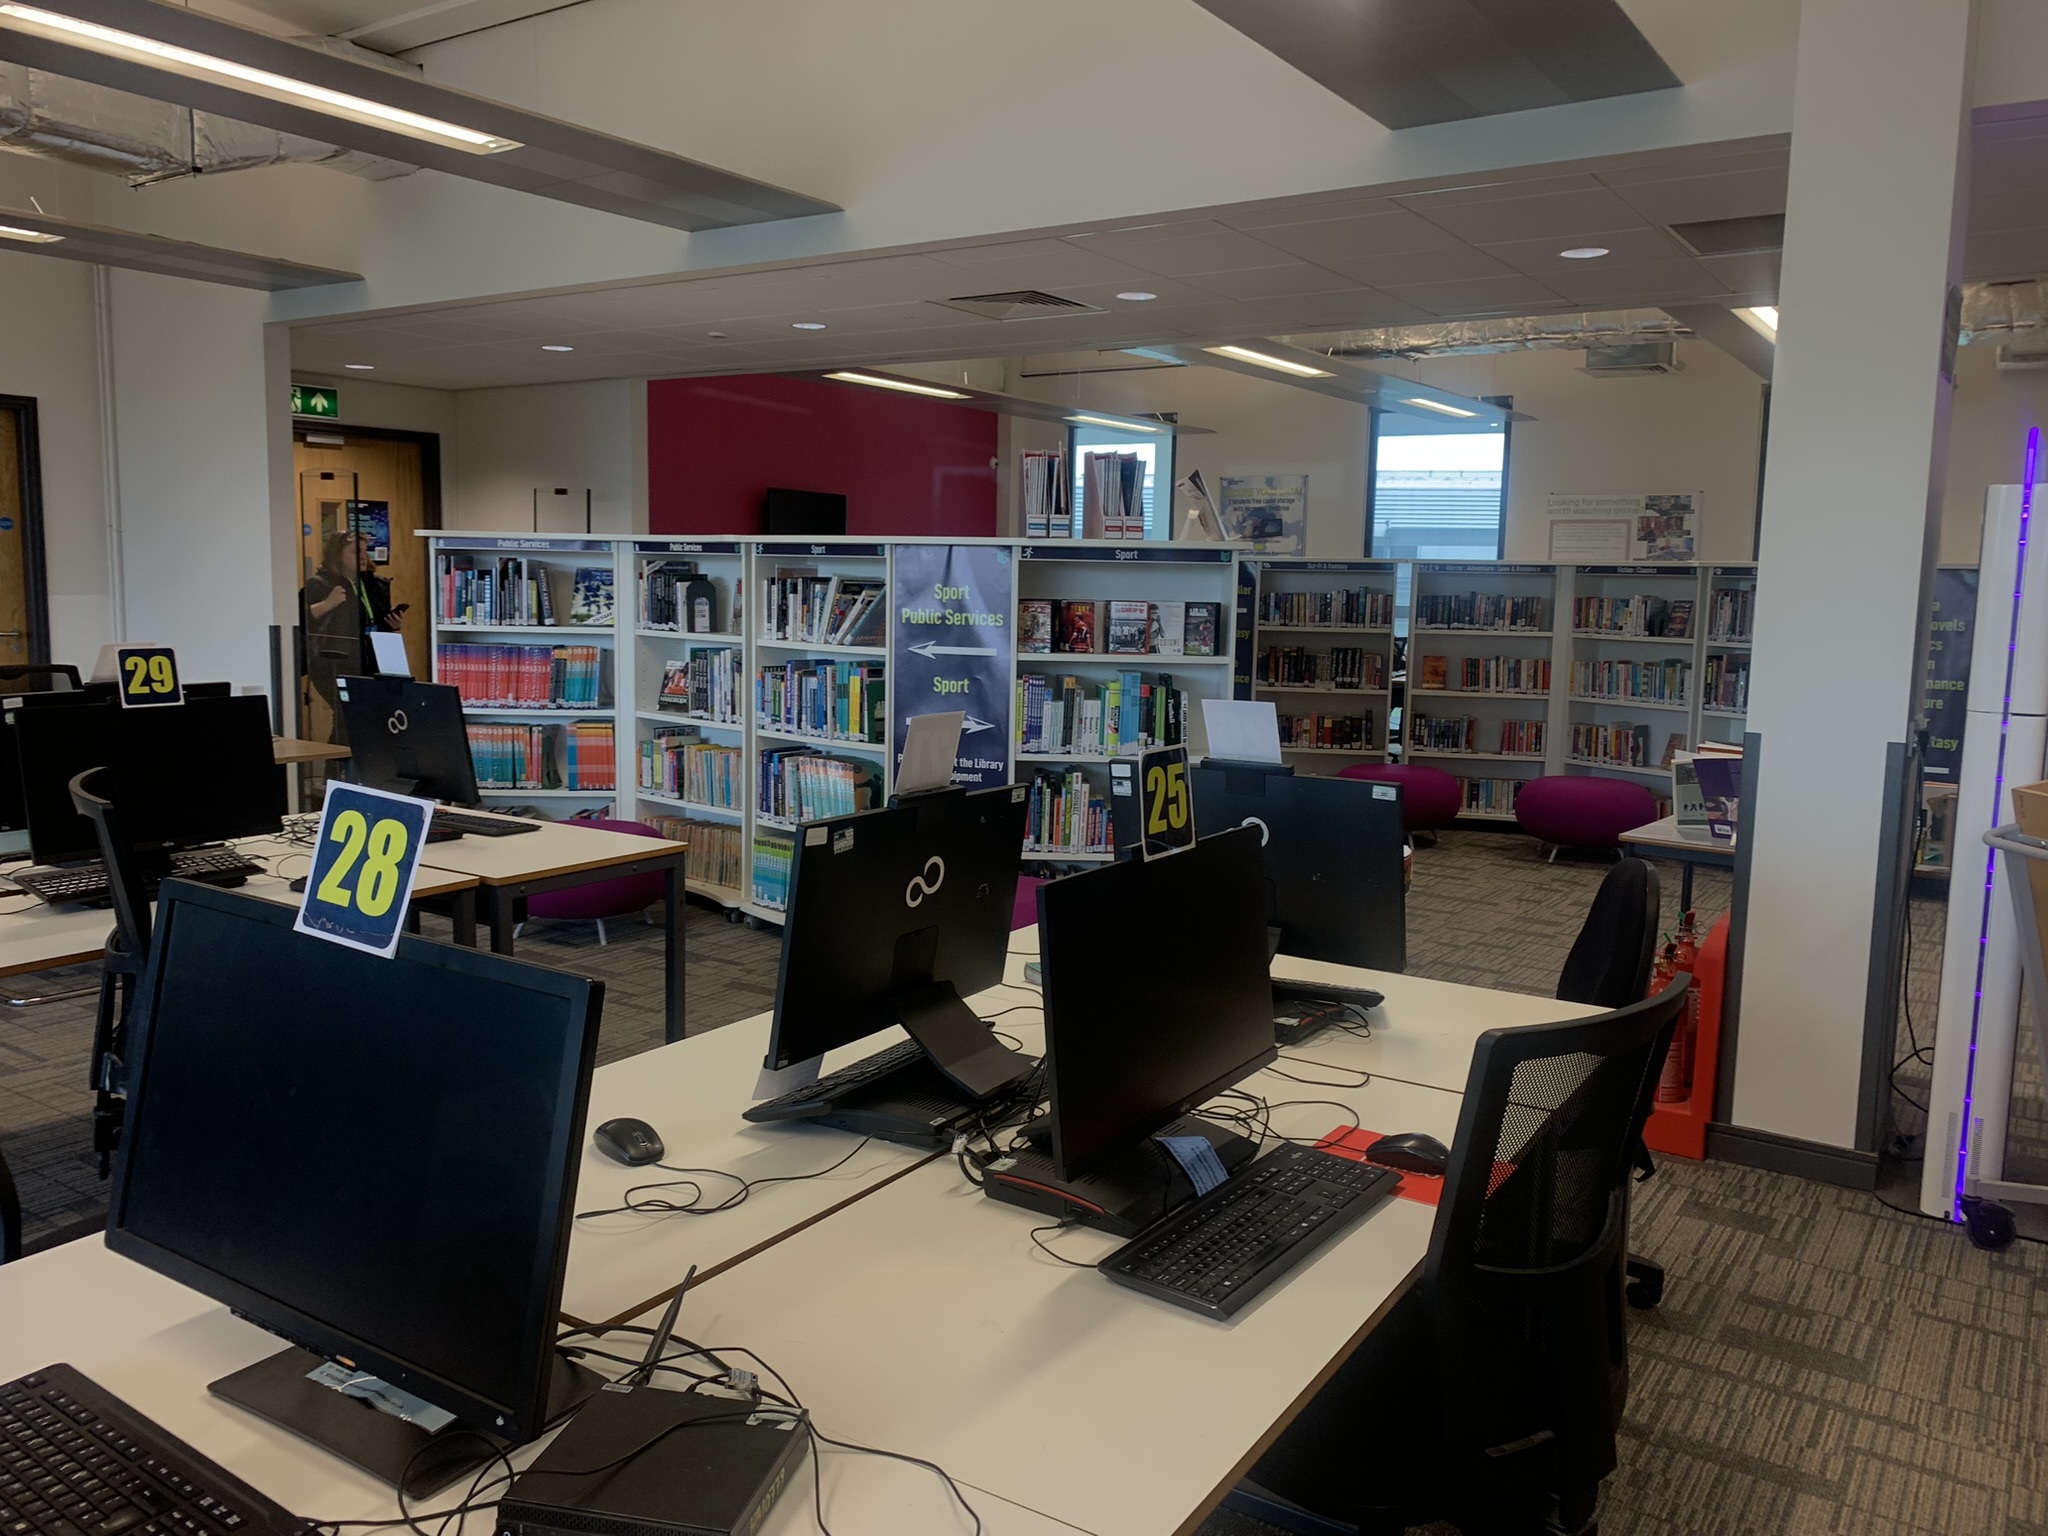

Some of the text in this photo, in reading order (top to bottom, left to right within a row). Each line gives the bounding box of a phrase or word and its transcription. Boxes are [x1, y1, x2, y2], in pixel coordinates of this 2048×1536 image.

[1547, 498, 1641, 507] Looking for something
[1547, 507, 1571, 515] worth
[1573, 507, 1610, 516] watching
[498, 539, 550, 549] Public Services
[669, 543, 703, 552] Public Services
[811, 545, 826, 555] Sport
[1115, 549, 1138, 560] Sport
[1636, 566, 1657, 574] Classics
[934, 583, 970, 602] Sport
[902, 608, 1004, 627] Public Services
[1931, 619, 1965, 632] ovels
[125, 655, 175, 695] 29
[933, 676, 969, 695] Sport
[959, 758, 973, 768] the
[974, 758, 1004, 771] Library
[1147, 762, 1188, 835] 25
[316, 809, 408, 917] 28
